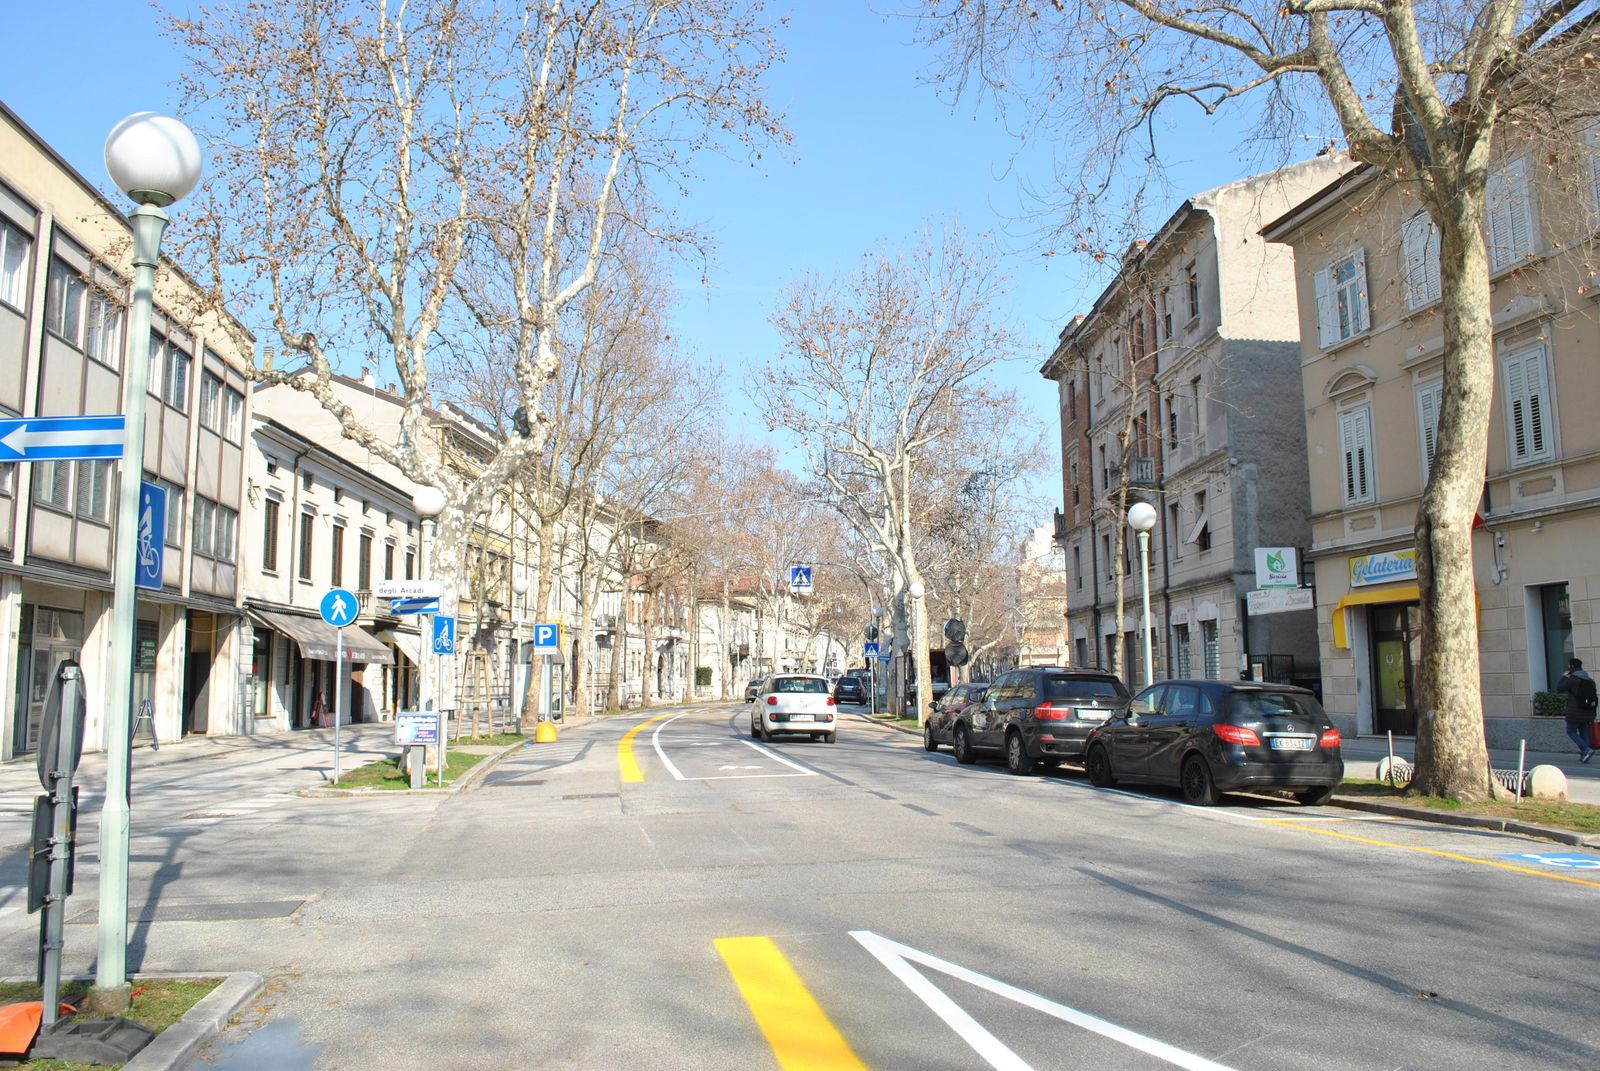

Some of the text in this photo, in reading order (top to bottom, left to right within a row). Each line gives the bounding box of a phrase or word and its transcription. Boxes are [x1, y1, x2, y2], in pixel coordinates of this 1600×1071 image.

[1352, 555, 1413, 582] Gelateria
[378, 587, 397, 595] degli
[538, 626, 553, 645] P
